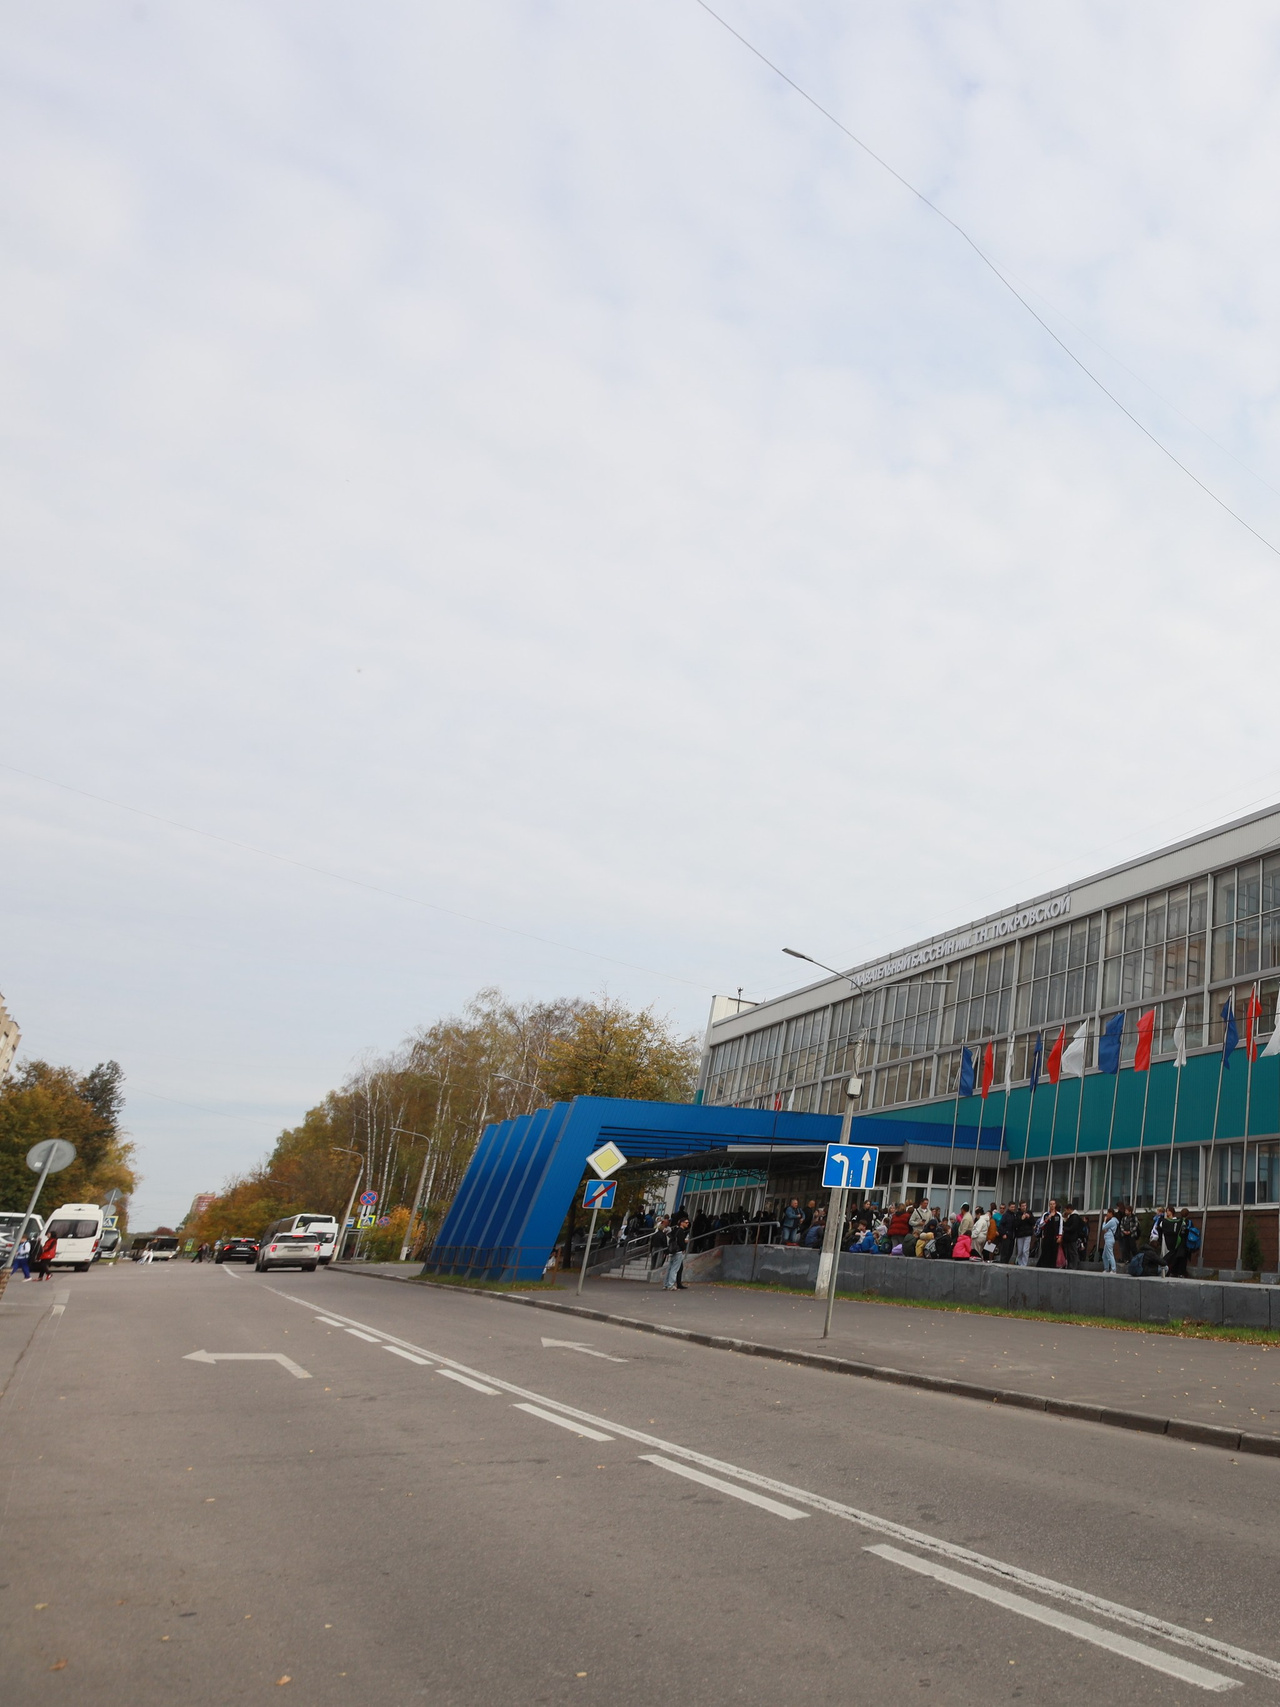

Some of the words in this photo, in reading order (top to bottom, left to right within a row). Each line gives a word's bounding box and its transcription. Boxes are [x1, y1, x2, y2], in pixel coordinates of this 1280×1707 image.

[850, 953, 911, 990] ПЛАВАТЕЛЬНЫЙ
[911, 939, 954, 968] БАССЕЙН
[992, 893, 1071, 936] ПОКРОВСКОЙ
